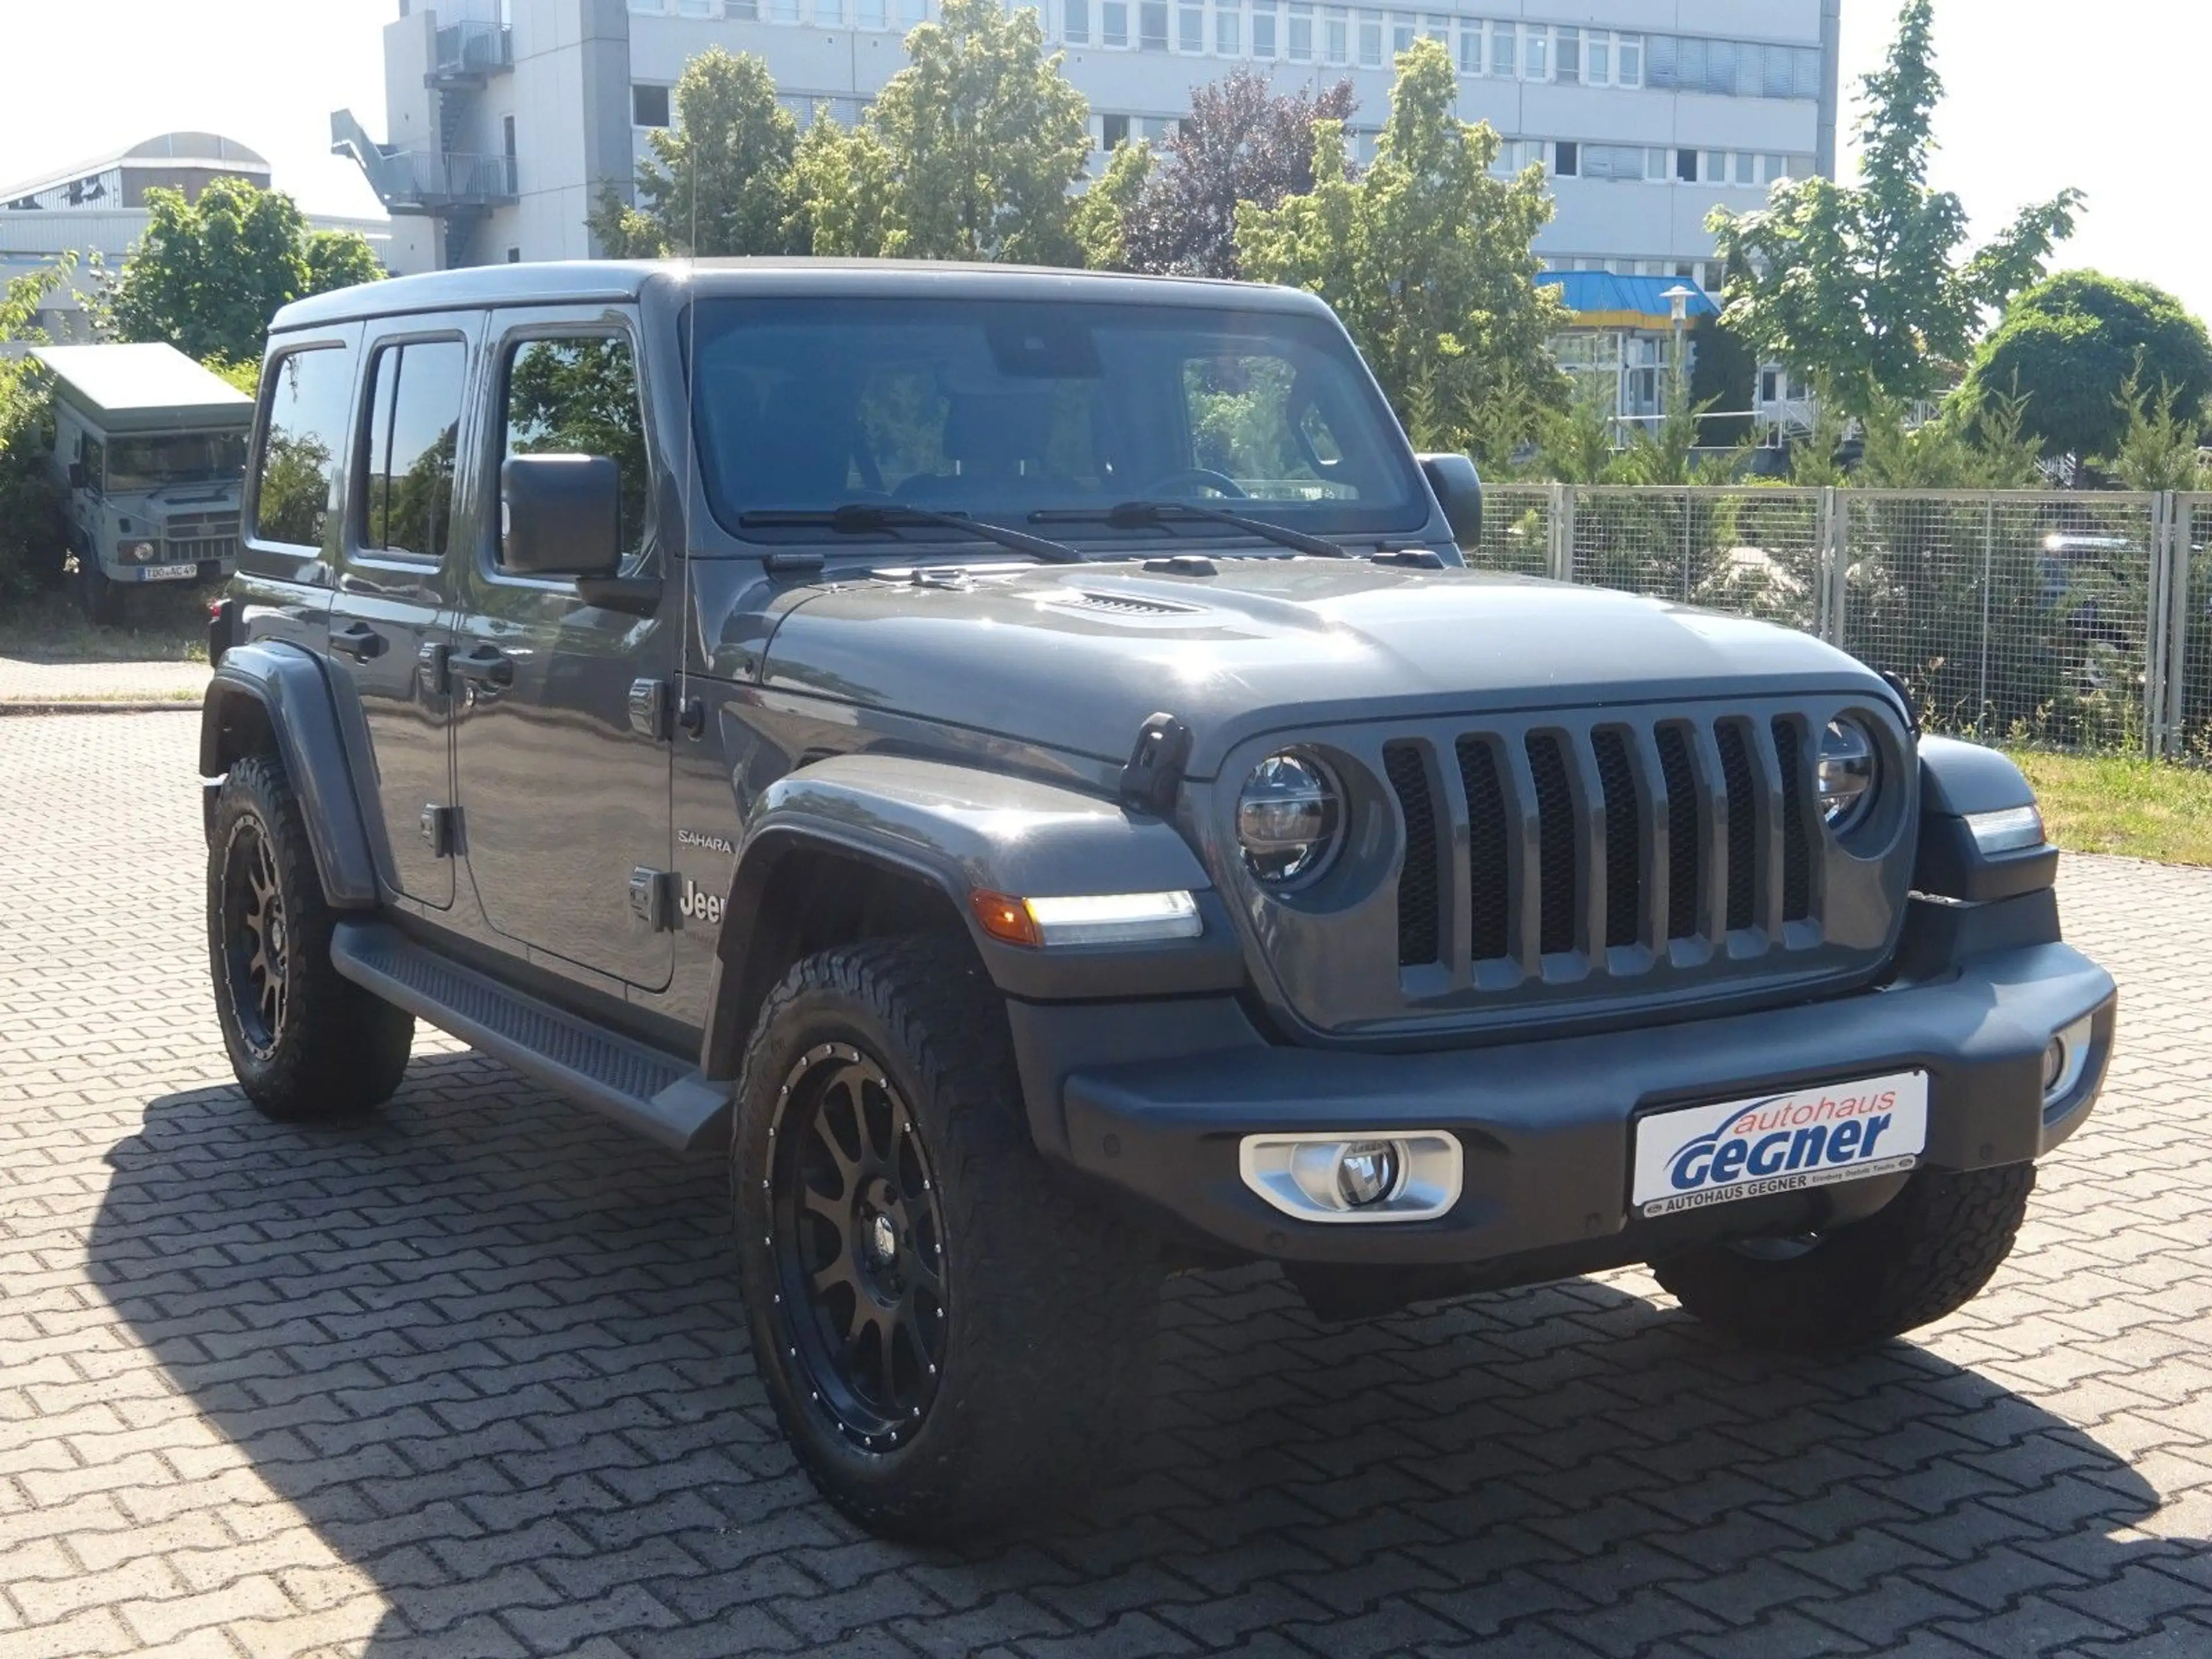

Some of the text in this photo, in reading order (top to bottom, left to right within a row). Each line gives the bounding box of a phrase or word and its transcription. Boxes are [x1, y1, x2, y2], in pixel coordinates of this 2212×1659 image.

[677, 829, 732, 854] SAHARA
[1733, 1090, 1896, 1135] autohaus
[1665, 1185, 1743, 1211] AUTOHAUS
[1748, 1175, 1807, 1195] GEGNER
